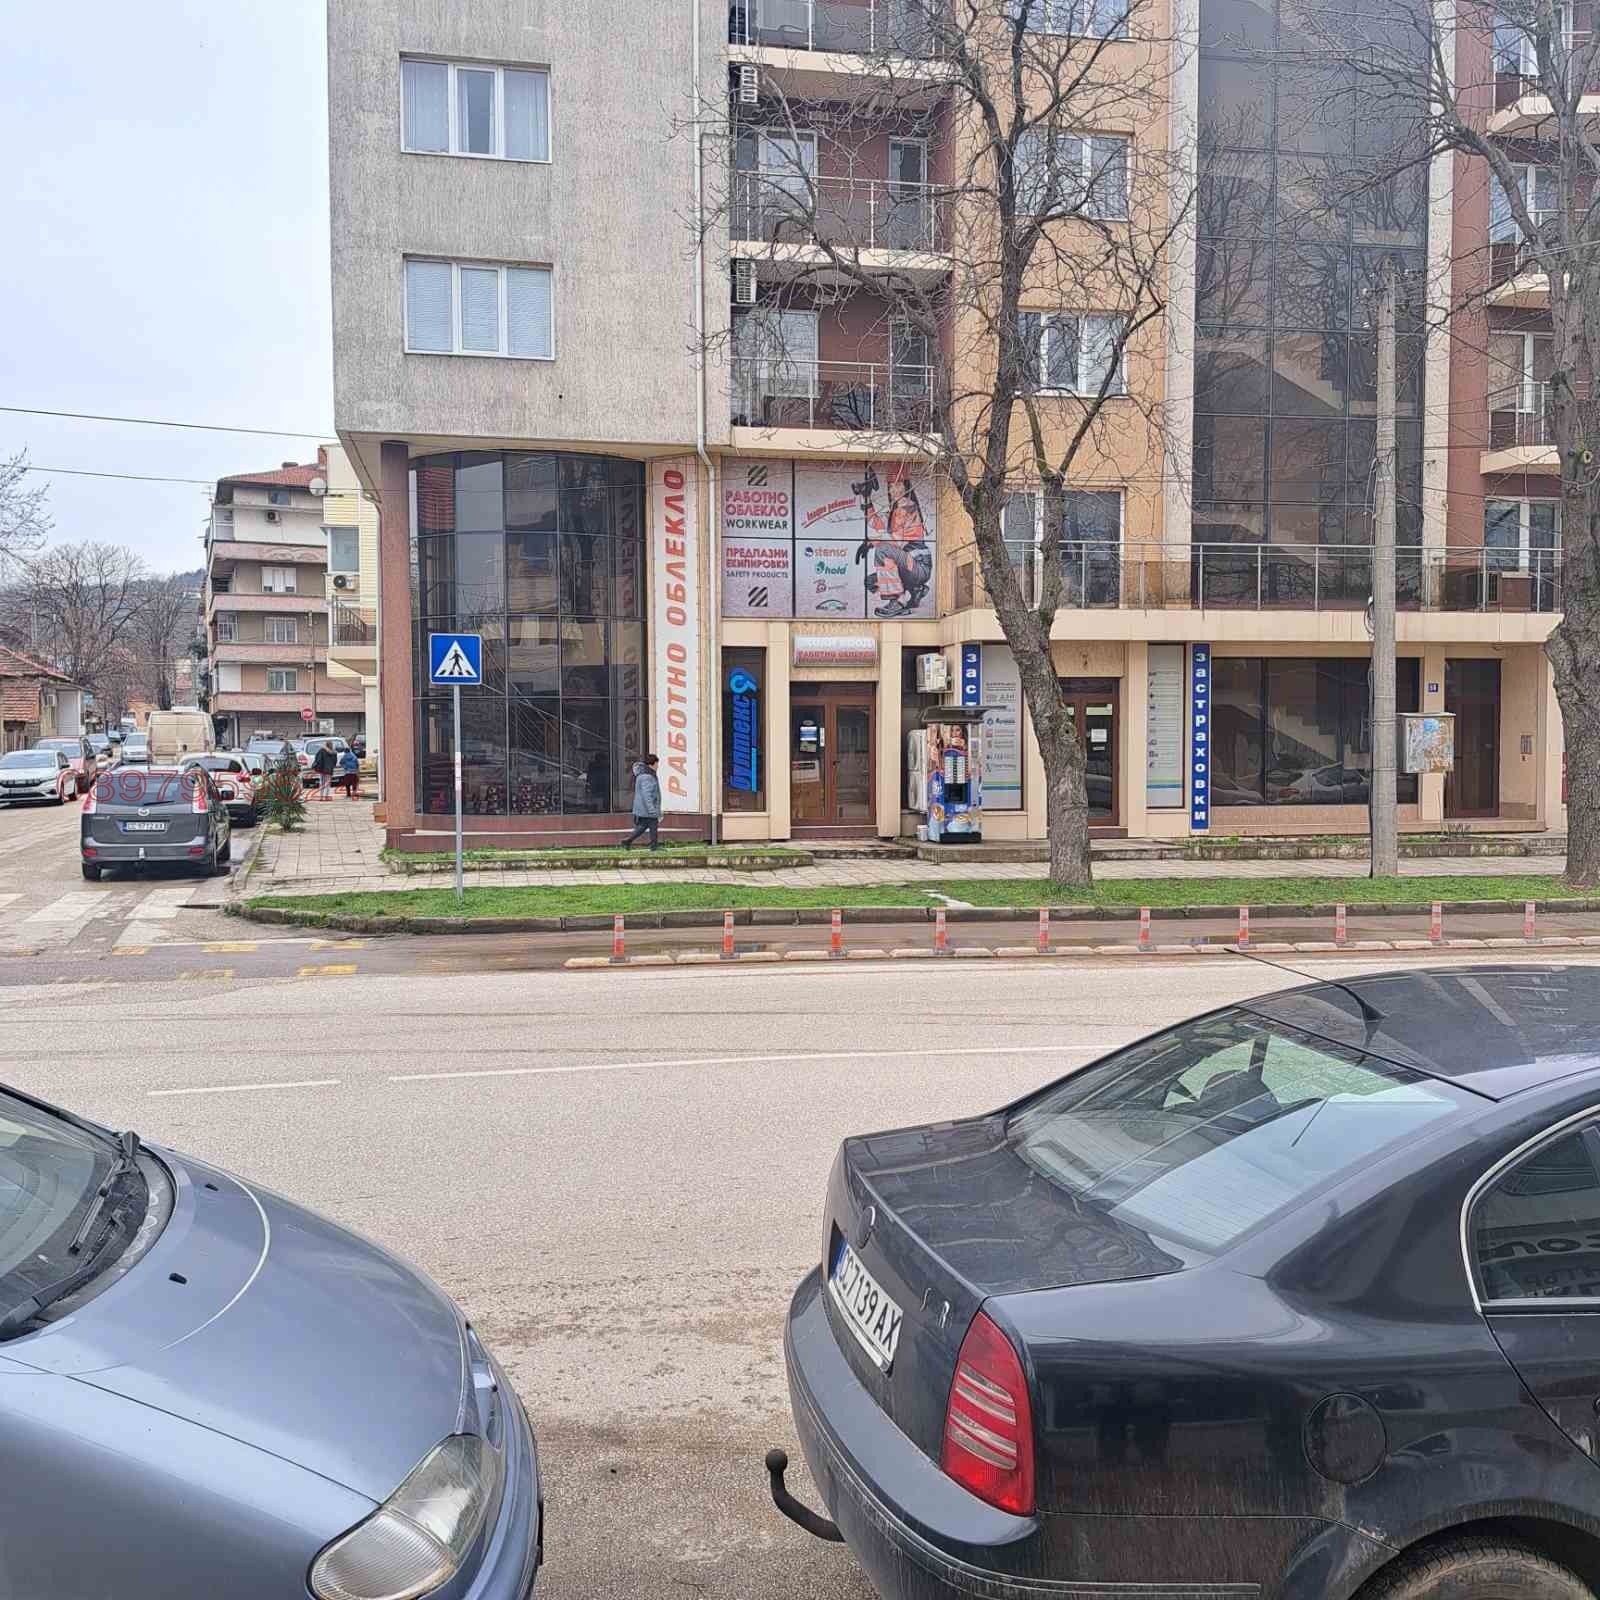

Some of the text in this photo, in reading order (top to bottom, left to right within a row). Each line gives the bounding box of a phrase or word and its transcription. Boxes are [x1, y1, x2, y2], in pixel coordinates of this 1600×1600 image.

[726, 489, 788, 504] РАБОТНО
[726, 504, 788, 517] ОБЛЕКЛО
[726, 518, 788, 529] WORKWEAR
[726, 548, 788, 558] ПРЕДПАЗНИ
[726, 559, 788, 569] ЕКИПИРОВКИ
[664, 470, 688, 797] РАБОТНО ОБЛЕКЛО
